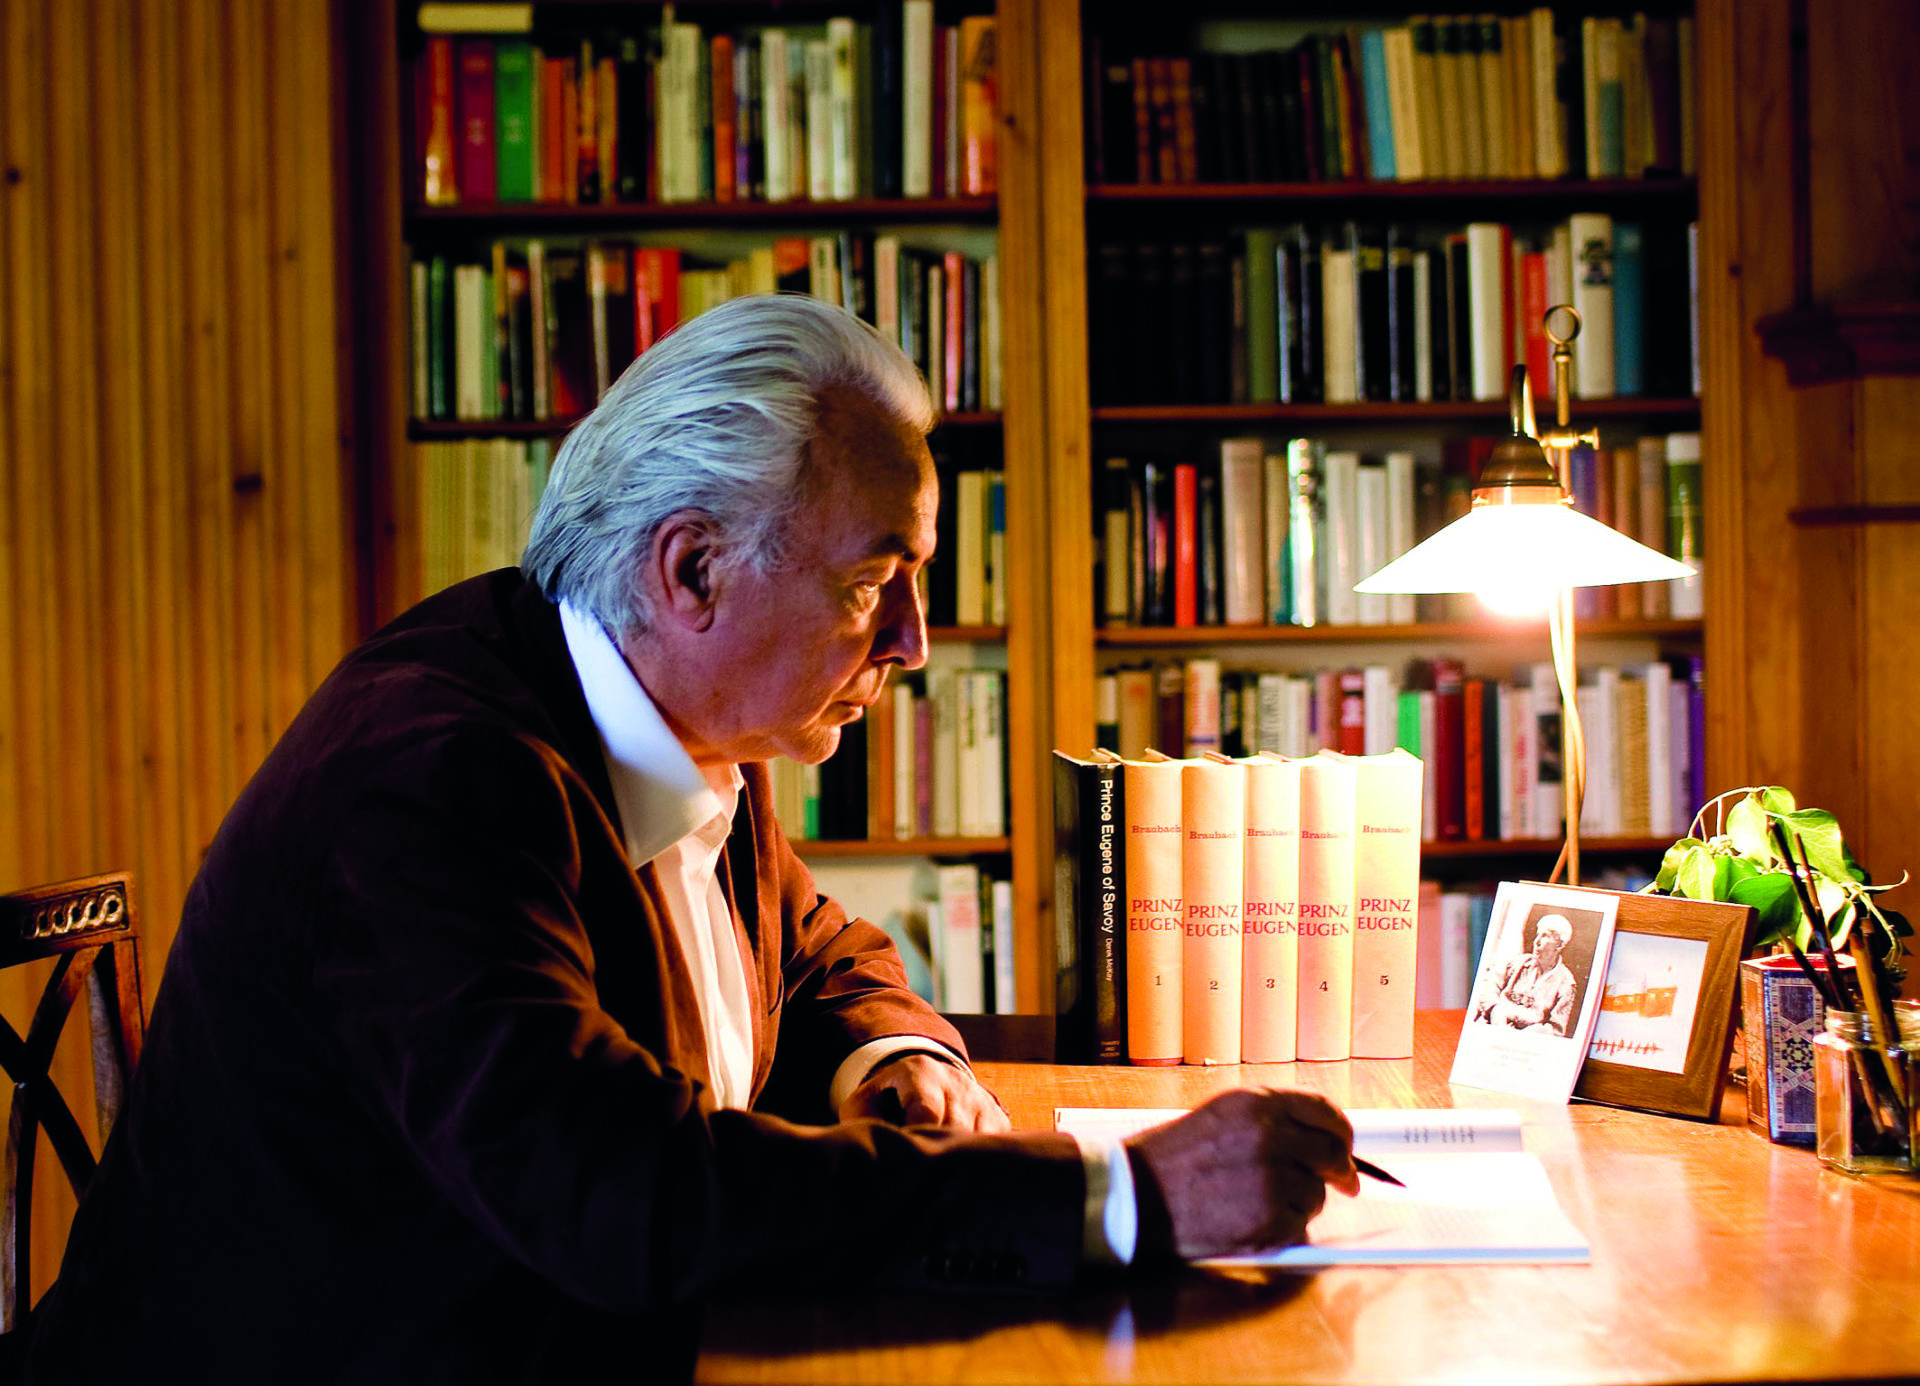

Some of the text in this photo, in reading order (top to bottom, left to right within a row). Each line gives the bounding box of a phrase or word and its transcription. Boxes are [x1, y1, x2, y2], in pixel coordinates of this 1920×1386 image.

[1132, 824, 1182, 833] Braubach
[1301, 831, 1349, 839] Brauba
[1099, 779, 1115, 933] Prince Eugene of Savoy
[1132, 899, 1183, 912] PRINZ
[1189, 905, 1238, 918] PRINZ
[1246, 902, 1295, 916] PRINZ
[1300, 904, 1348, 918] PRINZ
[1360, 899, 1411, 912] PRINZ
[1130, 917, 1184, 931] EUGEN
[1186, 923, 1239, 937] EUGEN
[1243, 920, 1296, 934] EUGEN
[1298, 923, 1349, 936] EUGEN
[1357, 917, 1412, 931] EUGEN
[1155, 975, 1163, 986] 1
[1209, 980, 1219, 990] 2
[1266, 978, 1275, 989] 3
[1319, 981, 1329, 992] 4
[1379, 975, 1389, 986] 5
